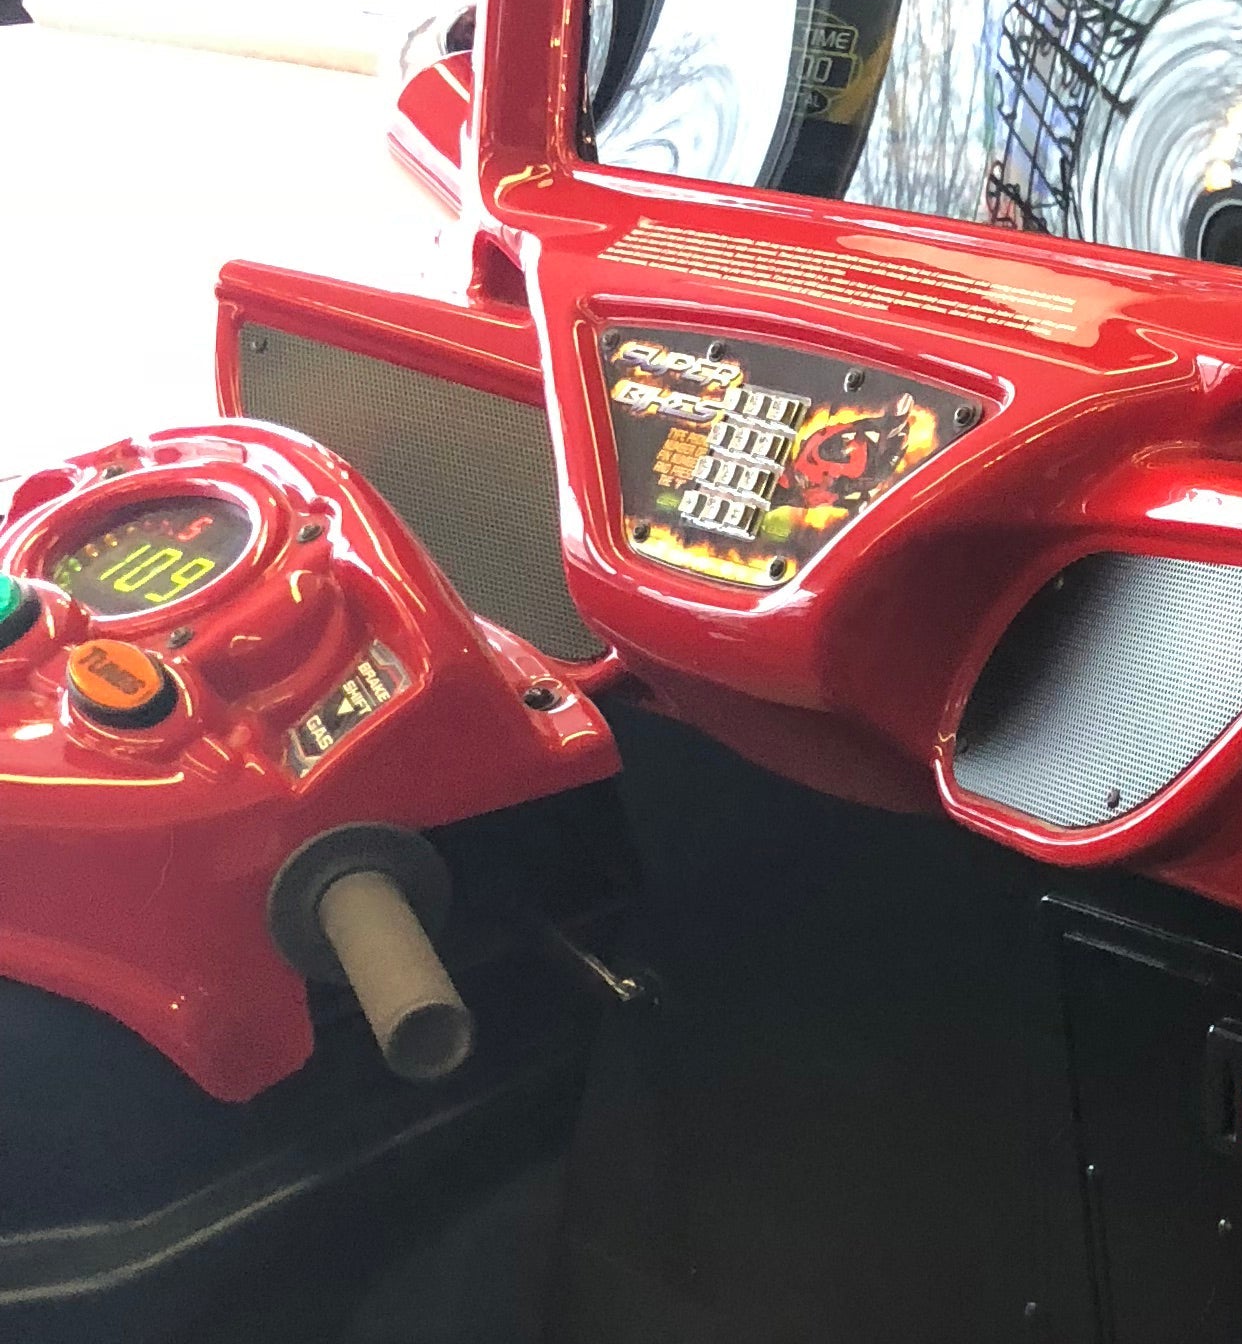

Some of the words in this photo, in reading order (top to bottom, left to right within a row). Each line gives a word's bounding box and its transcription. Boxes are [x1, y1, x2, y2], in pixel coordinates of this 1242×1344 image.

[622, 340, 741, 388] SUPER
[615, 380, 732, 423] BIKES
[98, 544, 216, 603] 109
[342, 679, 373, 716] SHIFT
[357, 661, 391, 703] BRAKE
[306, 714, 334, 750] GAS
